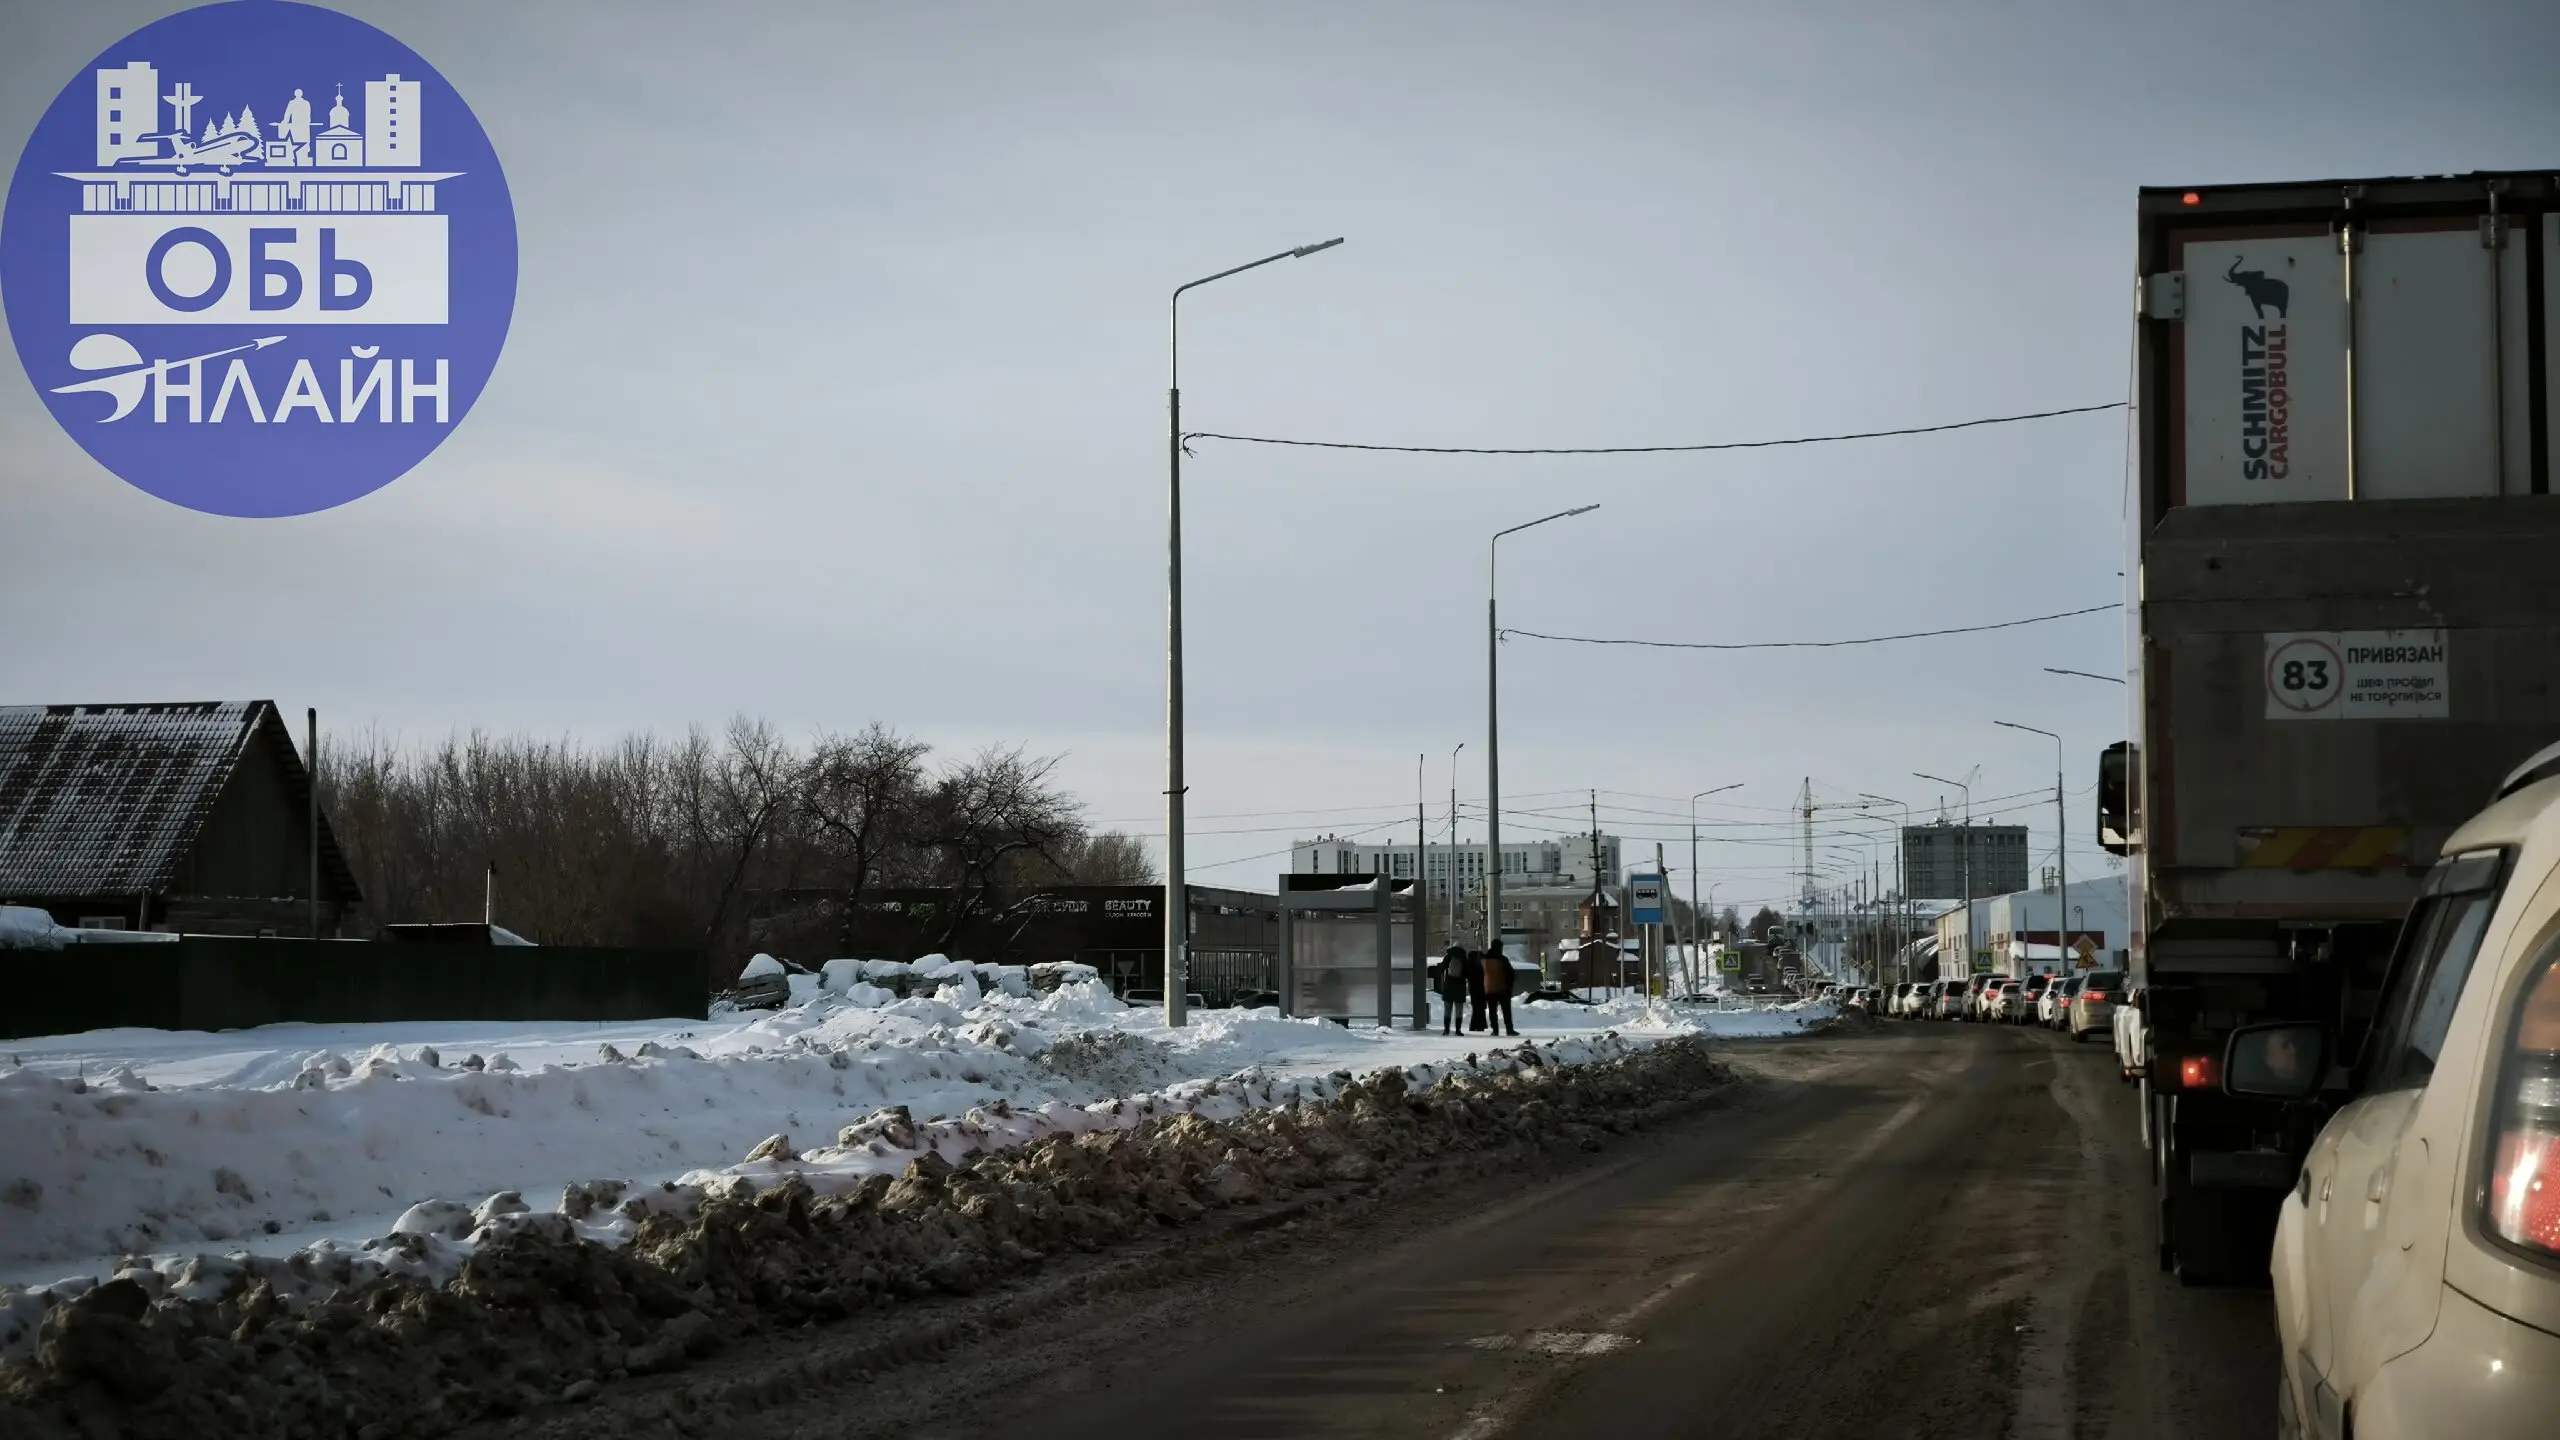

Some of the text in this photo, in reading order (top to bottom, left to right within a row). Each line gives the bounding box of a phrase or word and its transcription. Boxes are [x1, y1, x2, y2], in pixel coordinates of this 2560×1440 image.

[2242, 325, 2268, 480] SCHMITZ
[2267, 324, 2289, 480] CARGOBULL
[2347, 646, 2443, 664] ПРИВЯЗАН
[2283, 660, 2329, 690] 83
[2357, 678, 2384, 689] ШЕФ
[2350, 693, 2365, 702] НЕ
[1104, 899, 1152, 911] BEAUTY
